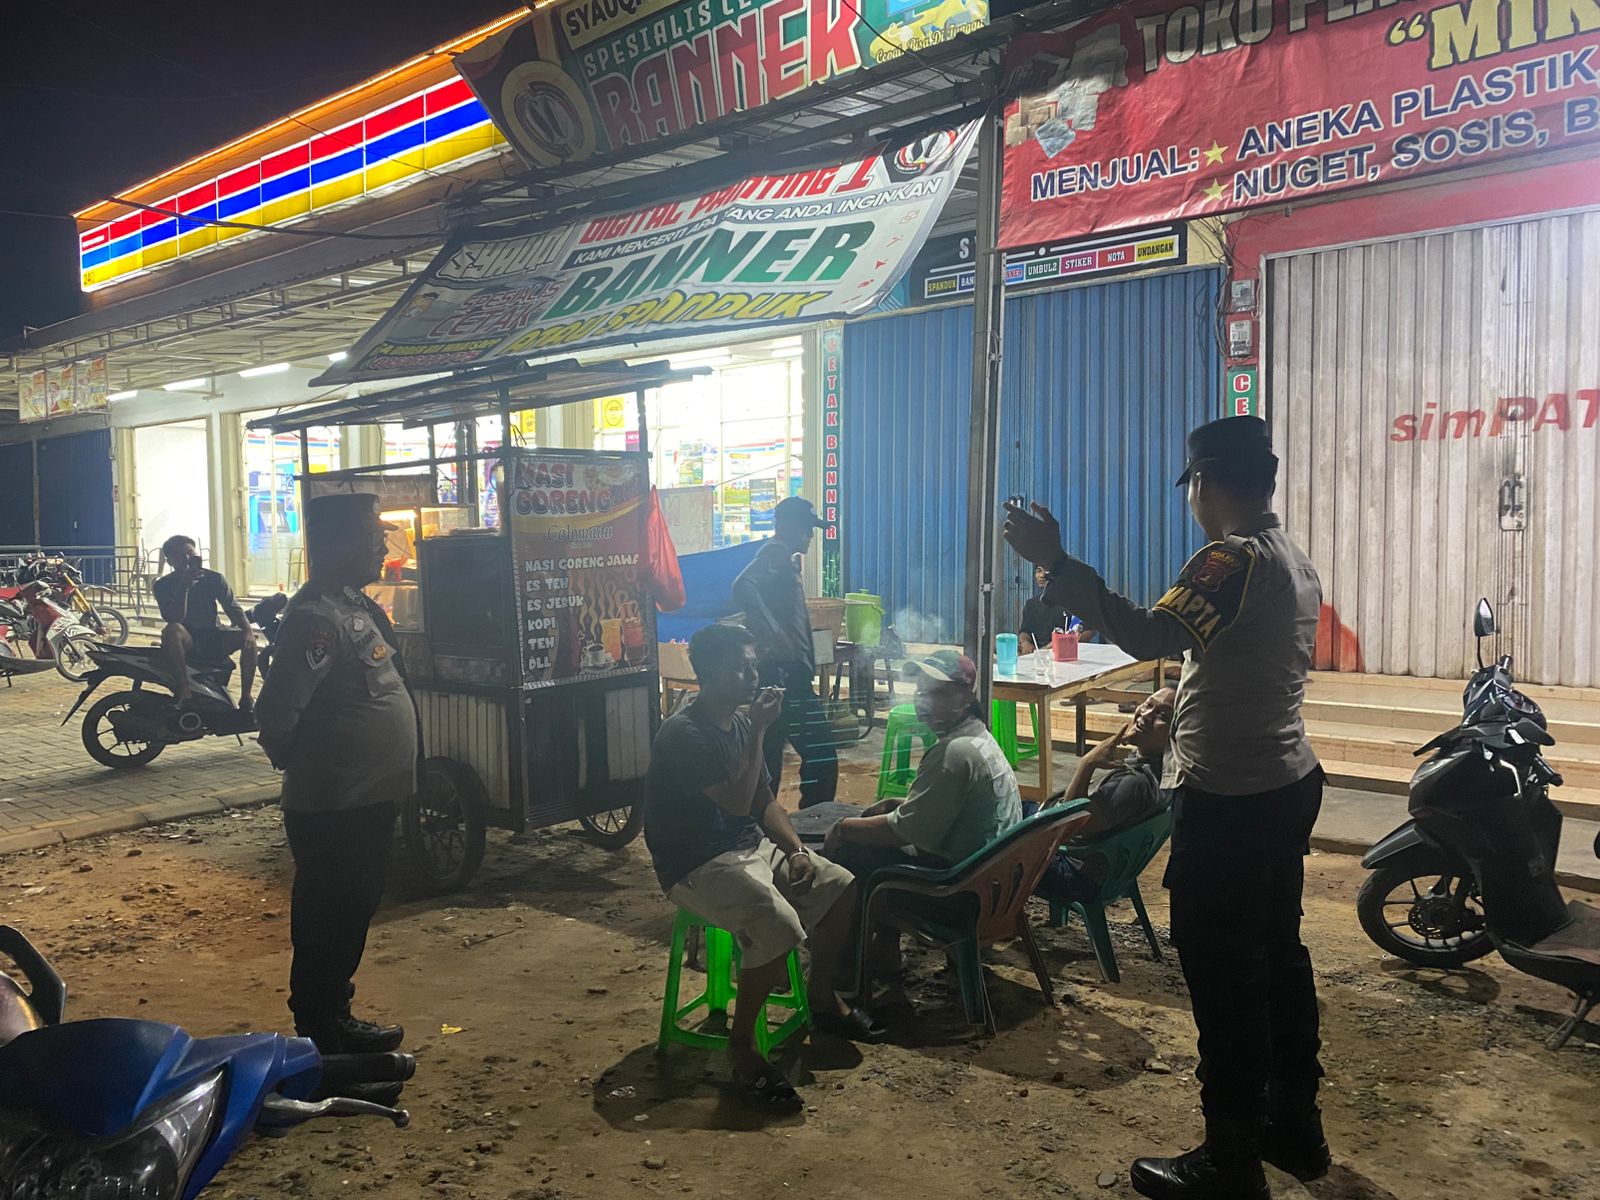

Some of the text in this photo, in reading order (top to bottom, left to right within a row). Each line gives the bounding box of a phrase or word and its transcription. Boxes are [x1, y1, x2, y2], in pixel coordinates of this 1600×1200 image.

[584, 0, 712, 78] SPESIALIS
[1135, 0, 1273, 72] TOKO
[1030, 145, 1200, 202] MENJUAL:
[1237, 100, 1384, 161] ANEKA
[1233, 143, 1381, 202] NUGET,
[1392, 107, 1550, 169] SOSIS,
[573, 176, 945, 265] KAMI MENGERTI APA YANG ANDA INGINKAN
[579, 202, 684, 245] DIGITAL
[538, 220, 875, 323] BANNER
[927, 280, 957, 293] SPANDUK
[1028, 262, 1058, 276] UMBUL2
[1065, 256, 1093, 270] STIKER
[1107, 250, 1125, 263] NOTA
[1137, 243, 1174, 258] UNDANGAN
[515, 462, 574, 489] NASI
[515, 489, 612, 516] GORENG
[525, 559, 555, 573] NASI
[558, 556, 605, 570] GORENG
[526, 577, 569, 593] ES TEH
[527, 595, 584, 612] ES JERUK
[527, 616, 556, 632] KOPI
[527, 636, 556, 651] TEH
[528, 656, 552, 670] DLL
